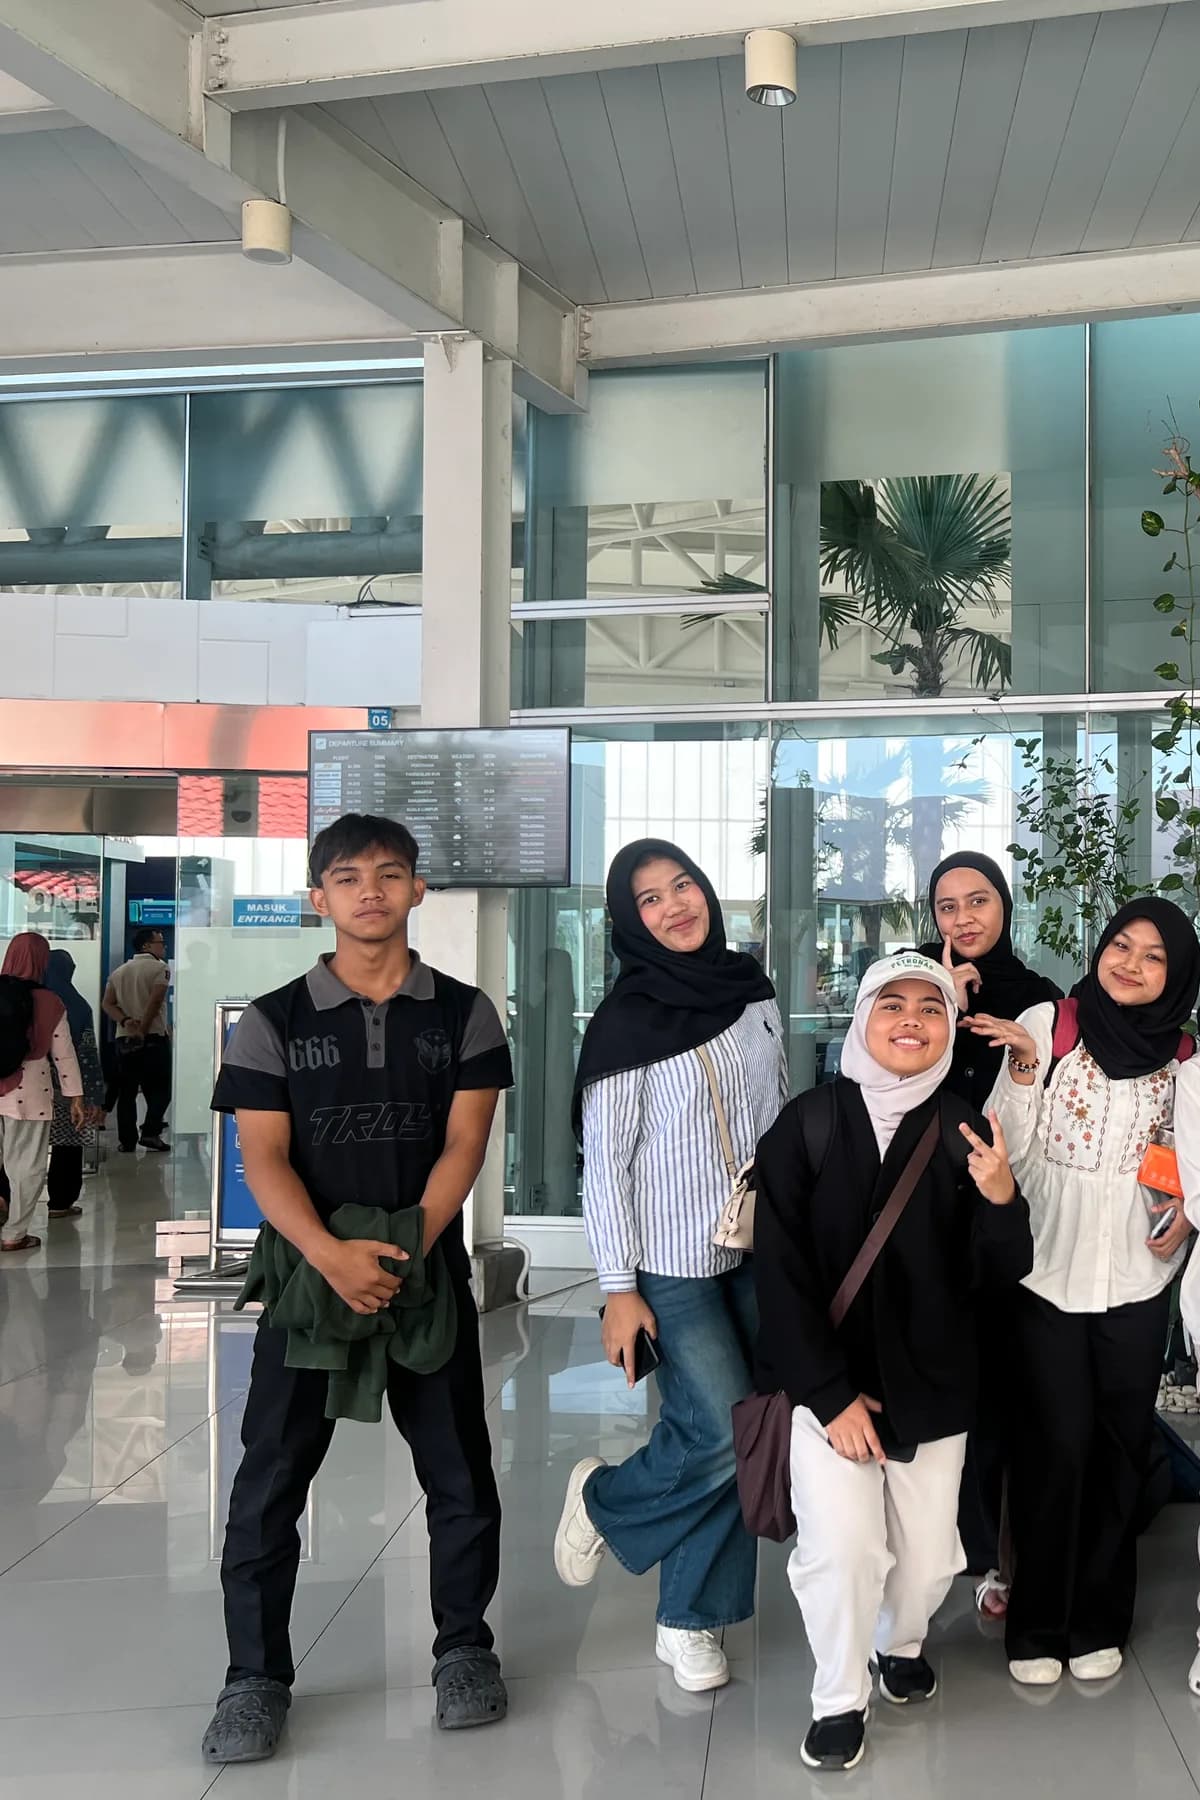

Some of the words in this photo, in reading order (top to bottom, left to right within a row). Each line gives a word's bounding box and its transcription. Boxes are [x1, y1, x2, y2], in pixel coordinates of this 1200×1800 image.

[372, 715, 388, 726] 05
[247, 903, 287, 912] MASUK
[237, 915, 297, 923] ENTRANCE
[890, 958, 934, 970] PETRONAS
[289, 1033, 341, 1072] 666
